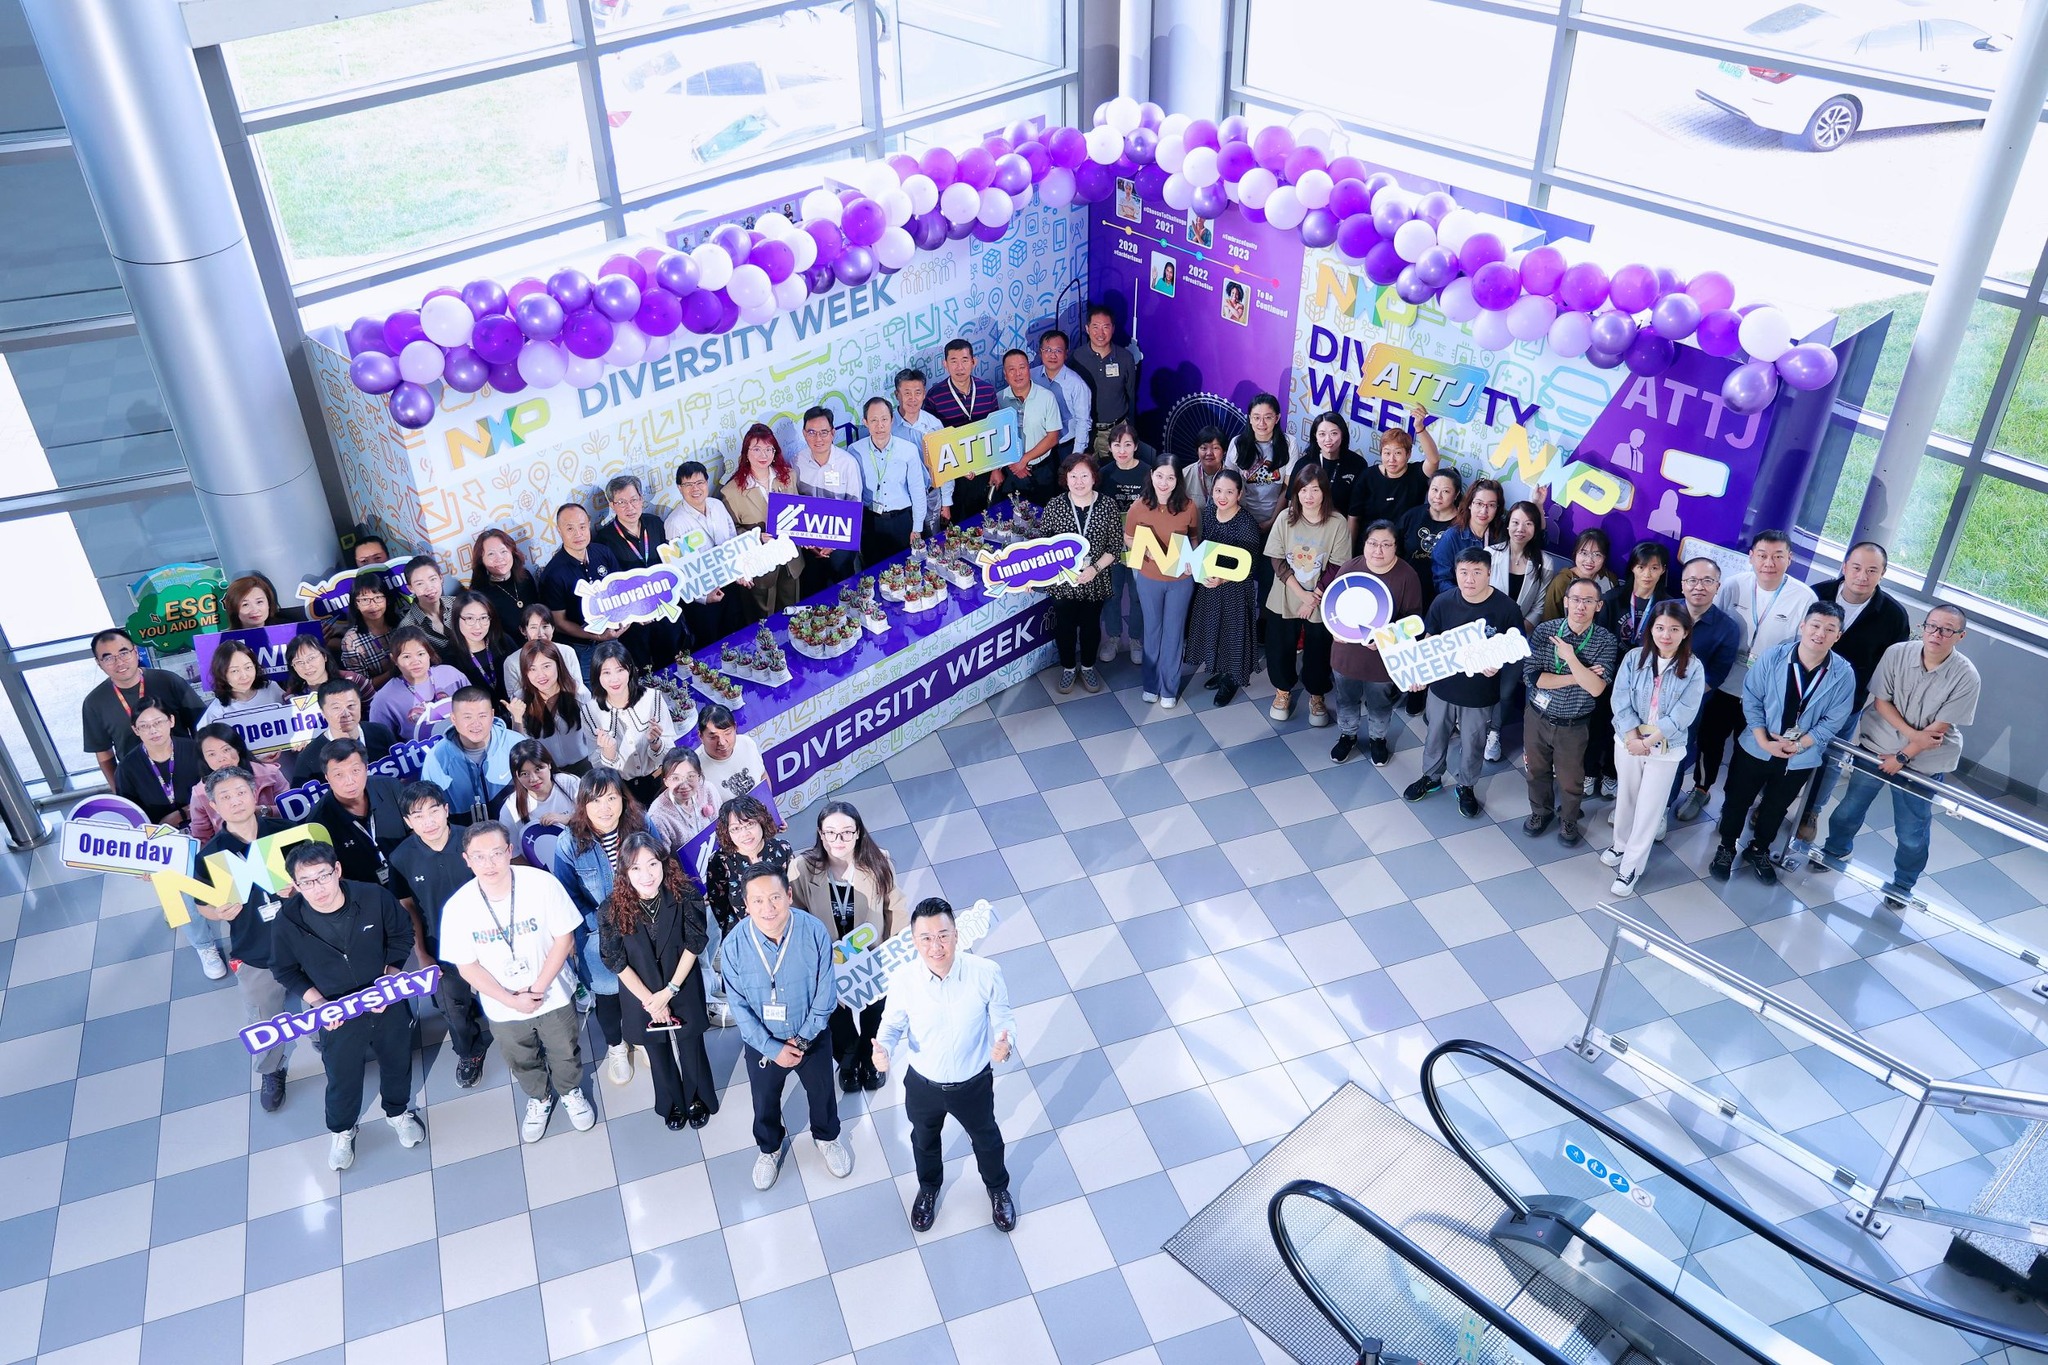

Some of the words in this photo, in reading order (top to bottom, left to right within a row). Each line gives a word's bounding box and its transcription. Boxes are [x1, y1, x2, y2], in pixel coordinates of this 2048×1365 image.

[1155, 219, 1174, 235] 2021
[1118, 239, 1138, 254] 2020
[1228, 244, 1250, 261] 2023
[1188, 264, 1208, 281] 2022
[1256, 300, 1288, 318] Continued
[1257, 289, 1264, 298] To
[1316, 263, 1418, 327] NXP
[578, 317, 779, 418] DIVERSITY
[789, 274, 897, 341] WEEK
[1372, 361, 1476, 408] ATTJ
[1621, 376, 1763, 449] ATTJ
[444, 397, 551, 470] NXP
[938, 424, 1012, 473] ATTJ
[1489, 422, 1621, 516] NXP
[803, 513, 852, 536] WIN
[660, 531, 704, 563] NXP
[681, 532, 761, 579] IVERSITY
[996, 545, 1075, 579] Innovation
[1127, 525, 1252, 584] NXP
[599, 577, 671, 613] Innovation
[681, 562, 743, 602] WEEK
[165, 594, 216, 621] ESG
[139, 625, 166, 639] YOU
[170, 619, 197, 633] AND
[200, 614, 220, 626] ME
[1375, 617, 1422, 649] NXP
[257, 643, 288, 667] WI
[1385, 622, 1483, 671] DIVERSITY
[1392, 651, 1463, 689] WEEK
[776, 670, 939, 782] DIVERSITY
[946, 615, 1037, 686] WEEK
[234, 718, 287, 743] Open
[79, 832, 135, 858] Open
[136, 840, 173, 865] day
[150, 823, 334, 928] NXP
[836, 930, 914, 995] DIVERS
[245, 969, 435, 1051] Diversity
